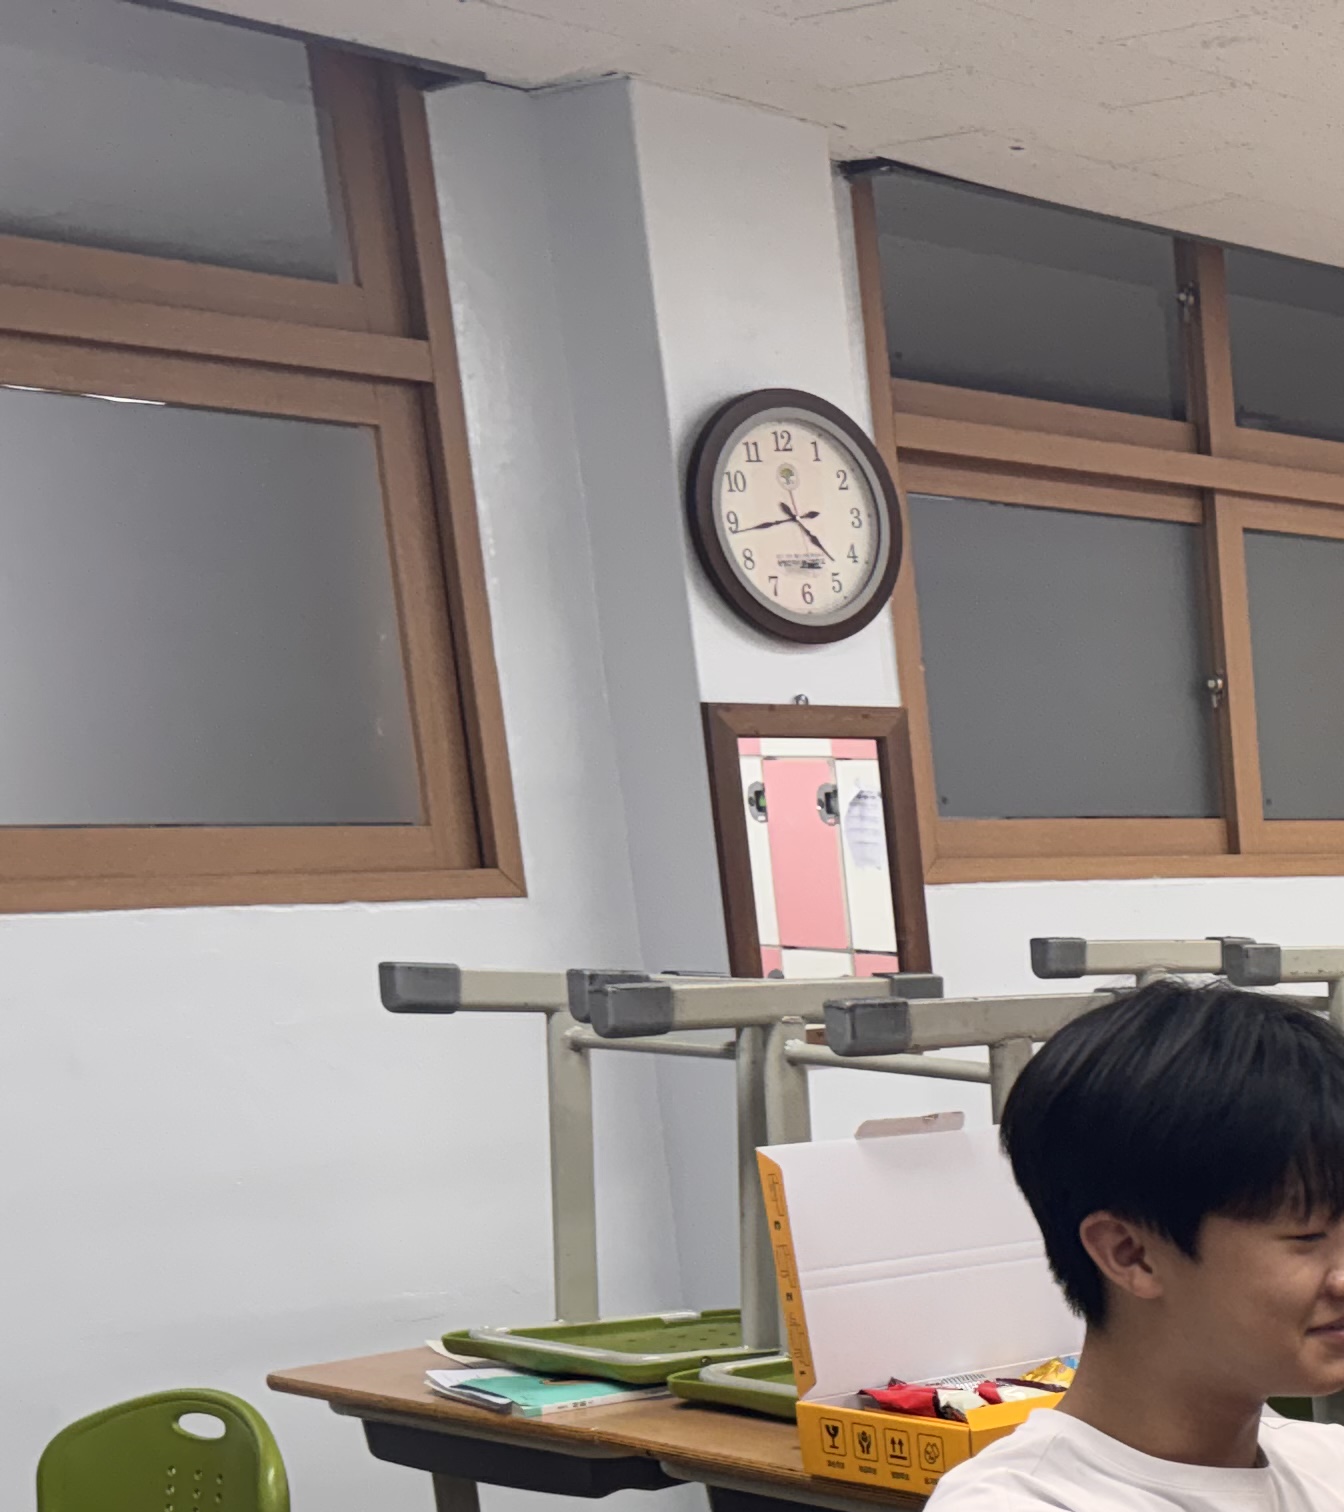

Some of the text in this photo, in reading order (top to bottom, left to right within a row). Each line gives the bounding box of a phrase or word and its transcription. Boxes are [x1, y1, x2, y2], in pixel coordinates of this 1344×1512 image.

[742, 441, 763, 463] 11
[771, 430, 793, 452] 12
[810, 441, 821, 462] 1
[725, 470, 747, 493] 10
[836, 469, 849, 491] 2
[726, 511, 739, 534] 9
[850, 507, 862, 529] 3
[742, 548, 755, 570] 8
[847, 543, 859, 563] 4
[768, 575, 779, 597] 7
[831, 572, 843, 593] 5
[801, 583, 814, 605] 6
